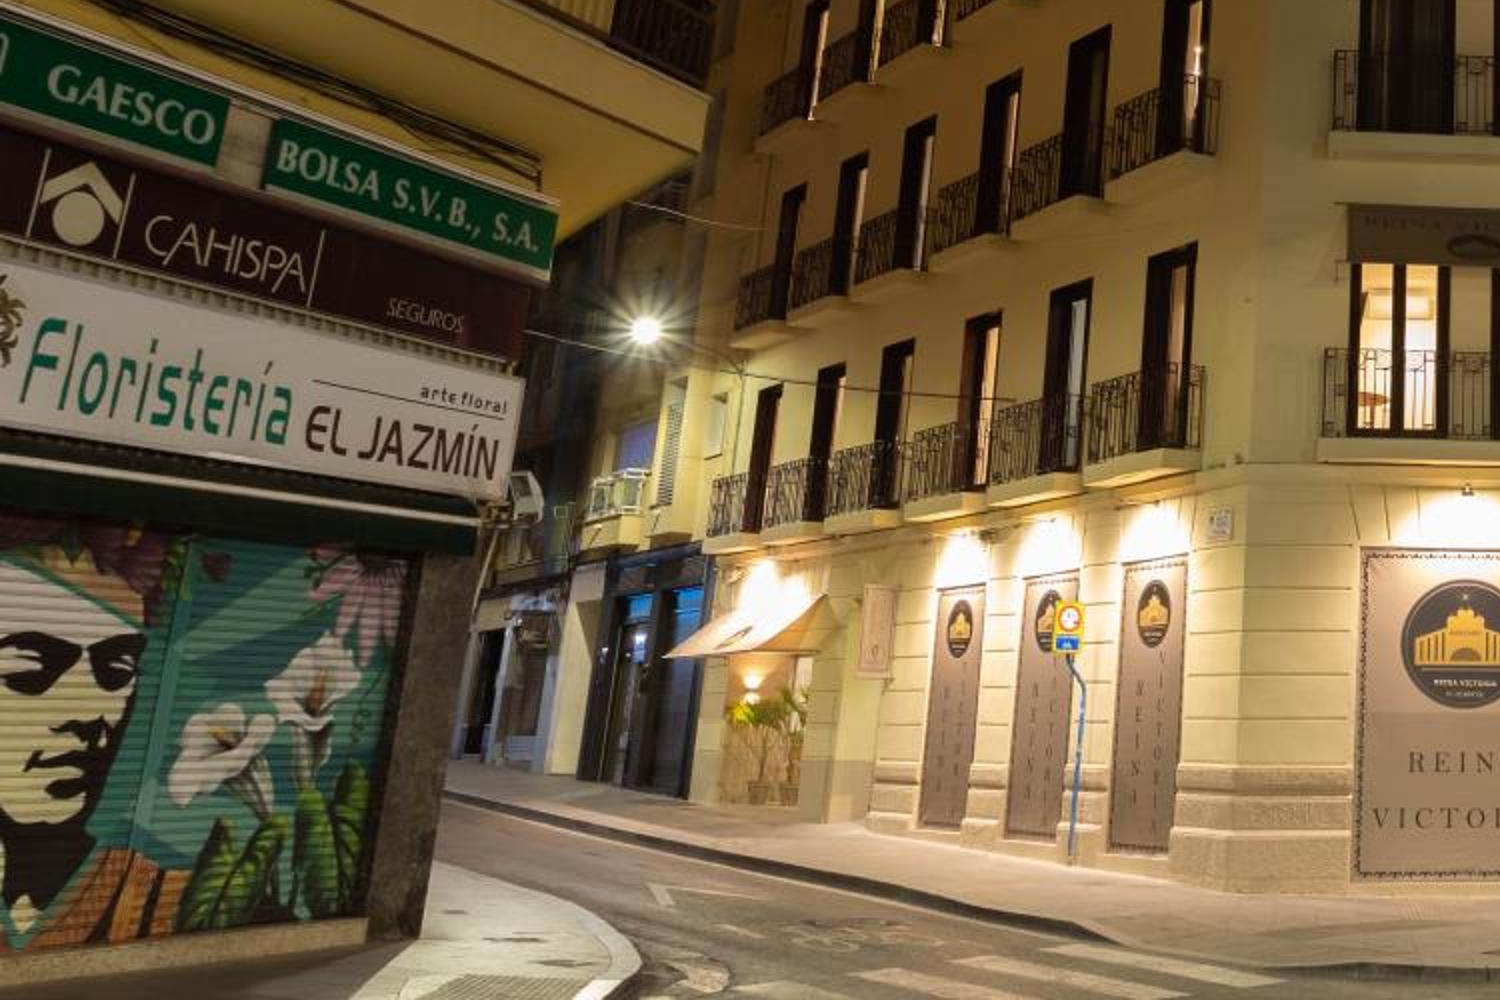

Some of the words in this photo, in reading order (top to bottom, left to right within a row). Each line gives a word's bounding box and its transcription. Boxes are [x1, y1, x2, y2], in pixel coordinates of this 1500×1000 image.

[47, 64, 217, 146] GAESCO
[277, 139, 380, 202] BOLSA
[491, 211, 541, 254] S.A.
[144, 215, 308, 296] CAHISPA
[386, 296, 466, 334] SEGUROS
[18, 316, 293, 446] Floristería
[304, 404, 348, 457] EL
[358, 421, 501, 481] JAZMÍN
